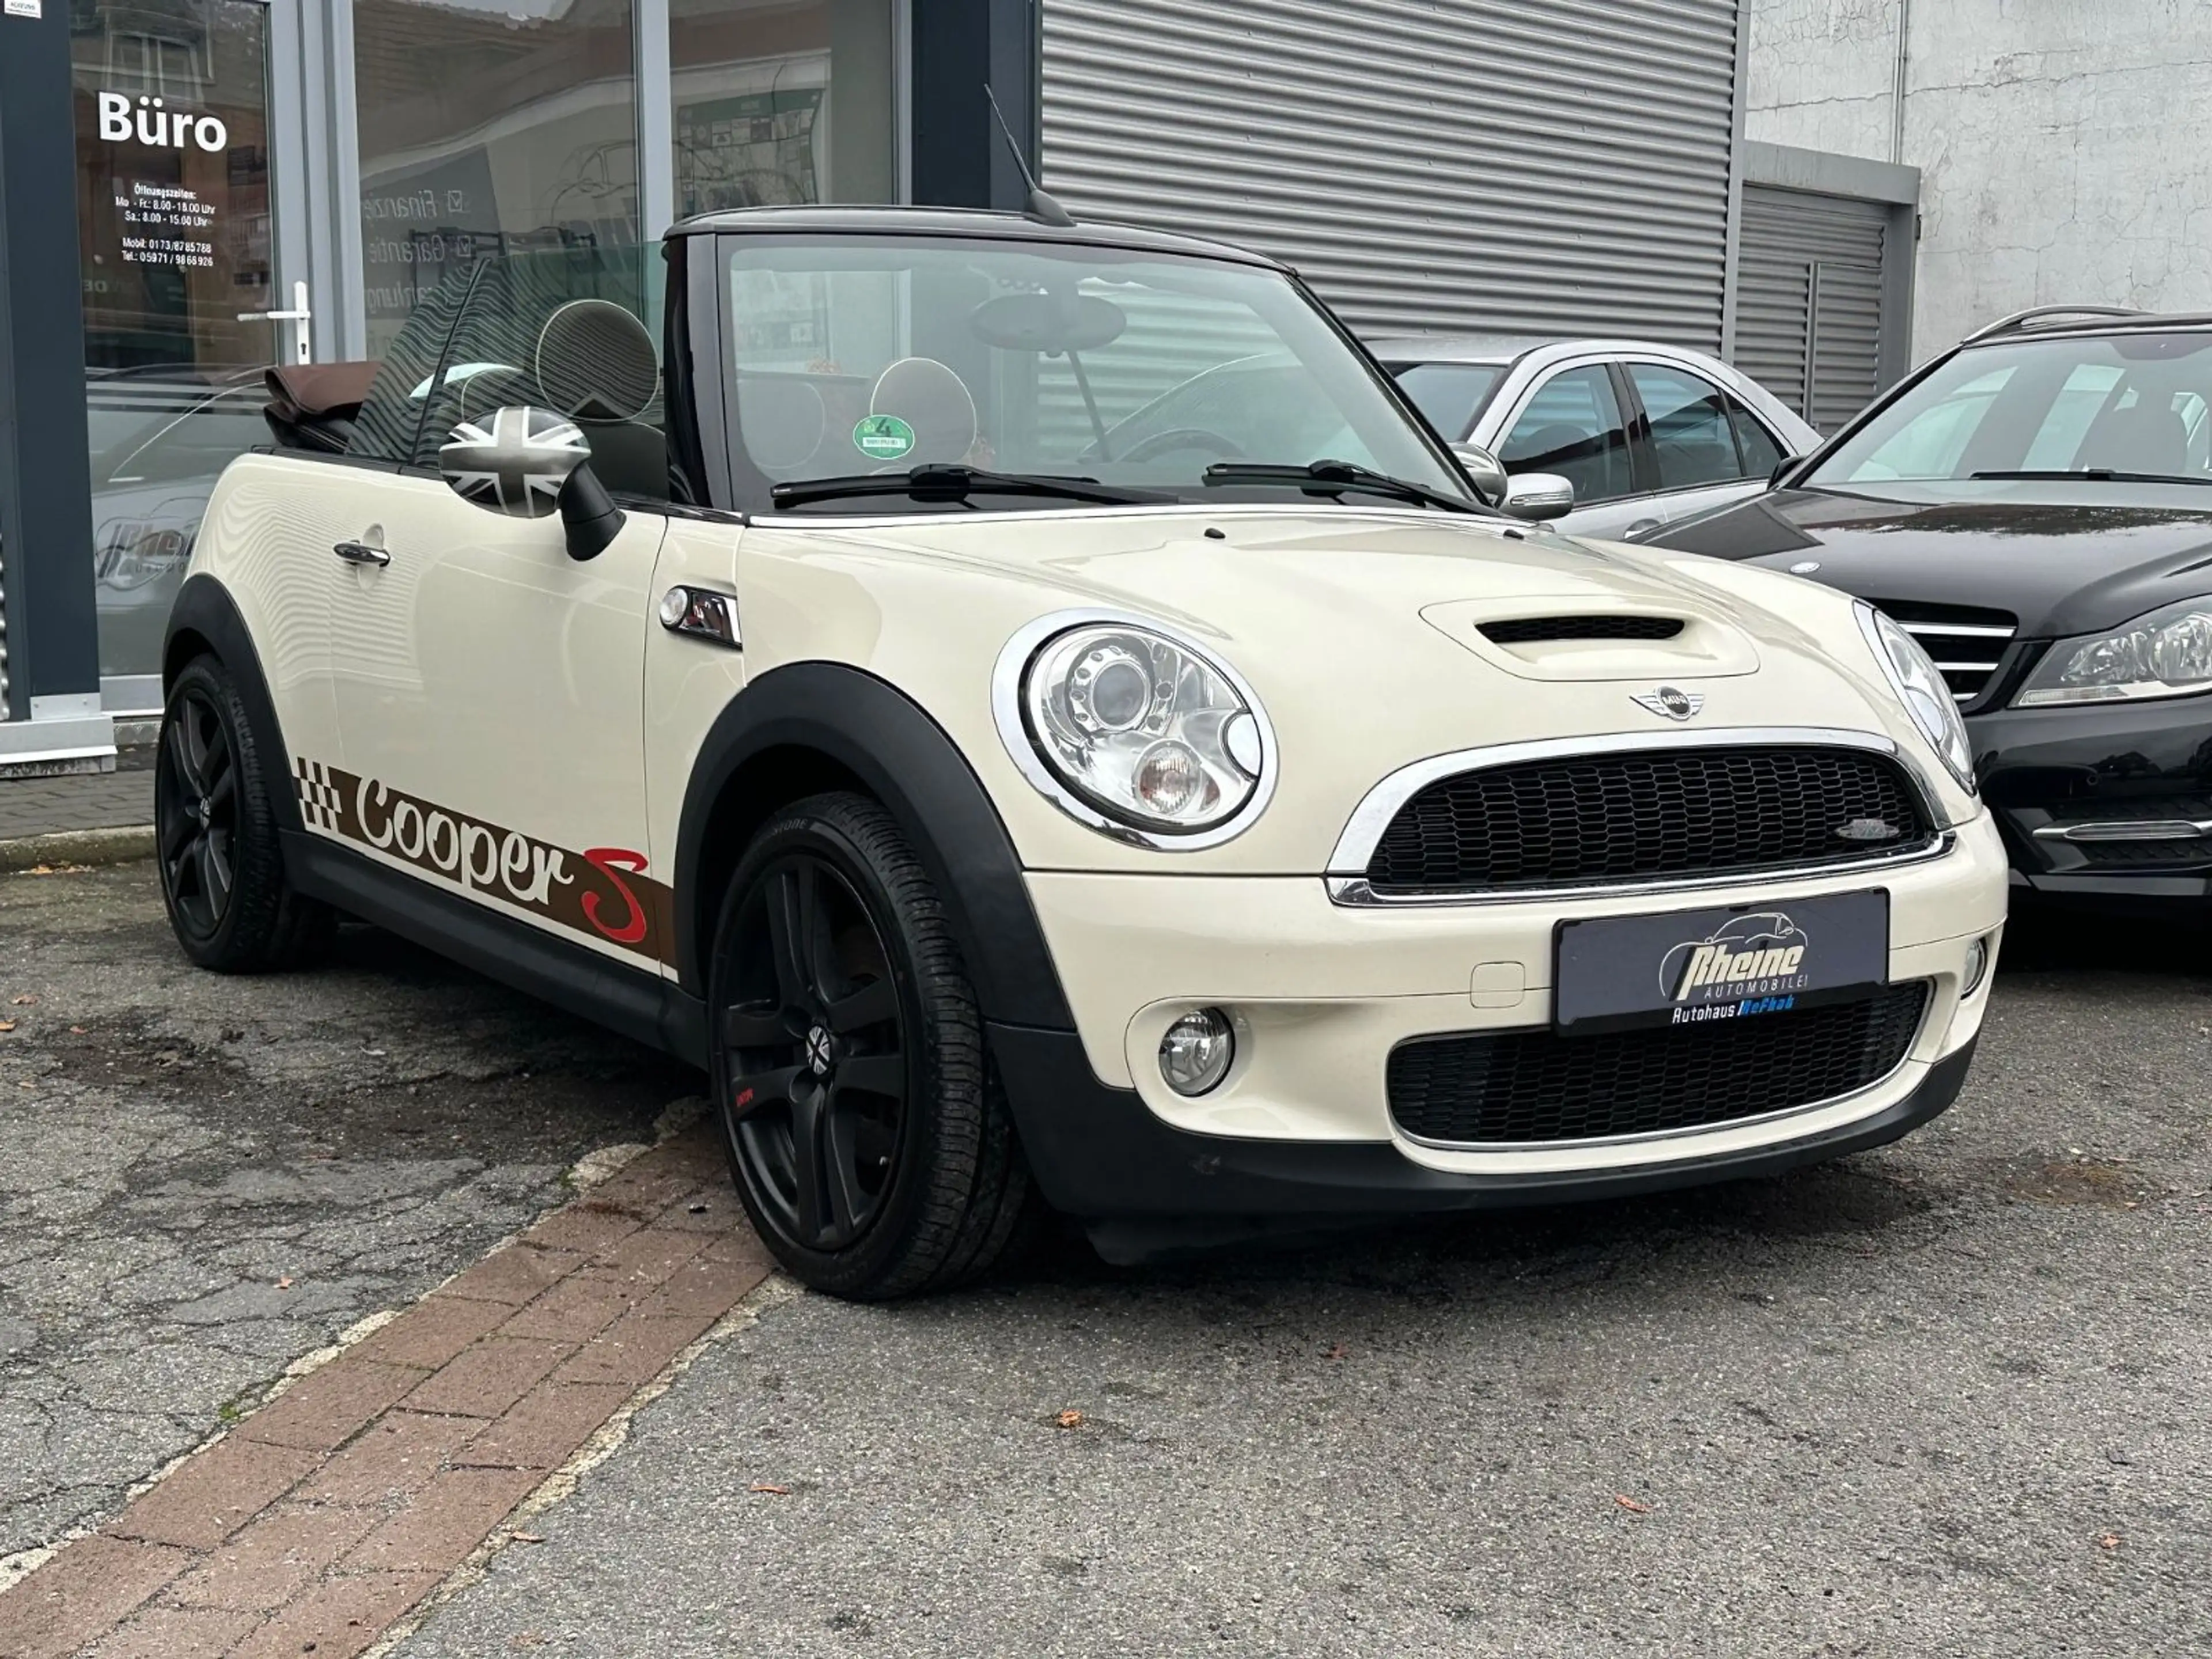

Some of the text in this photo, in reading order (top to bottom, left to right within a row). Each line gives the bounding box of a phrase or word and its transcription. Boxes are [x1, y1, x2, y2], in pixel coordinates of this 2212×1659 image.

[99, 92, 227, 151] Büro
[115, 196, 130, 207] Mo
[201, 203, 215, 215] Uhr
[193, 216, 207, 226] Uhr
[875, 418, 892, 438] 4
[1661, 695, 1688, 705] MINI
[357, 776, 649, 942] Cooper S
[1672, 1003, 1736, 1024] Autohaus
